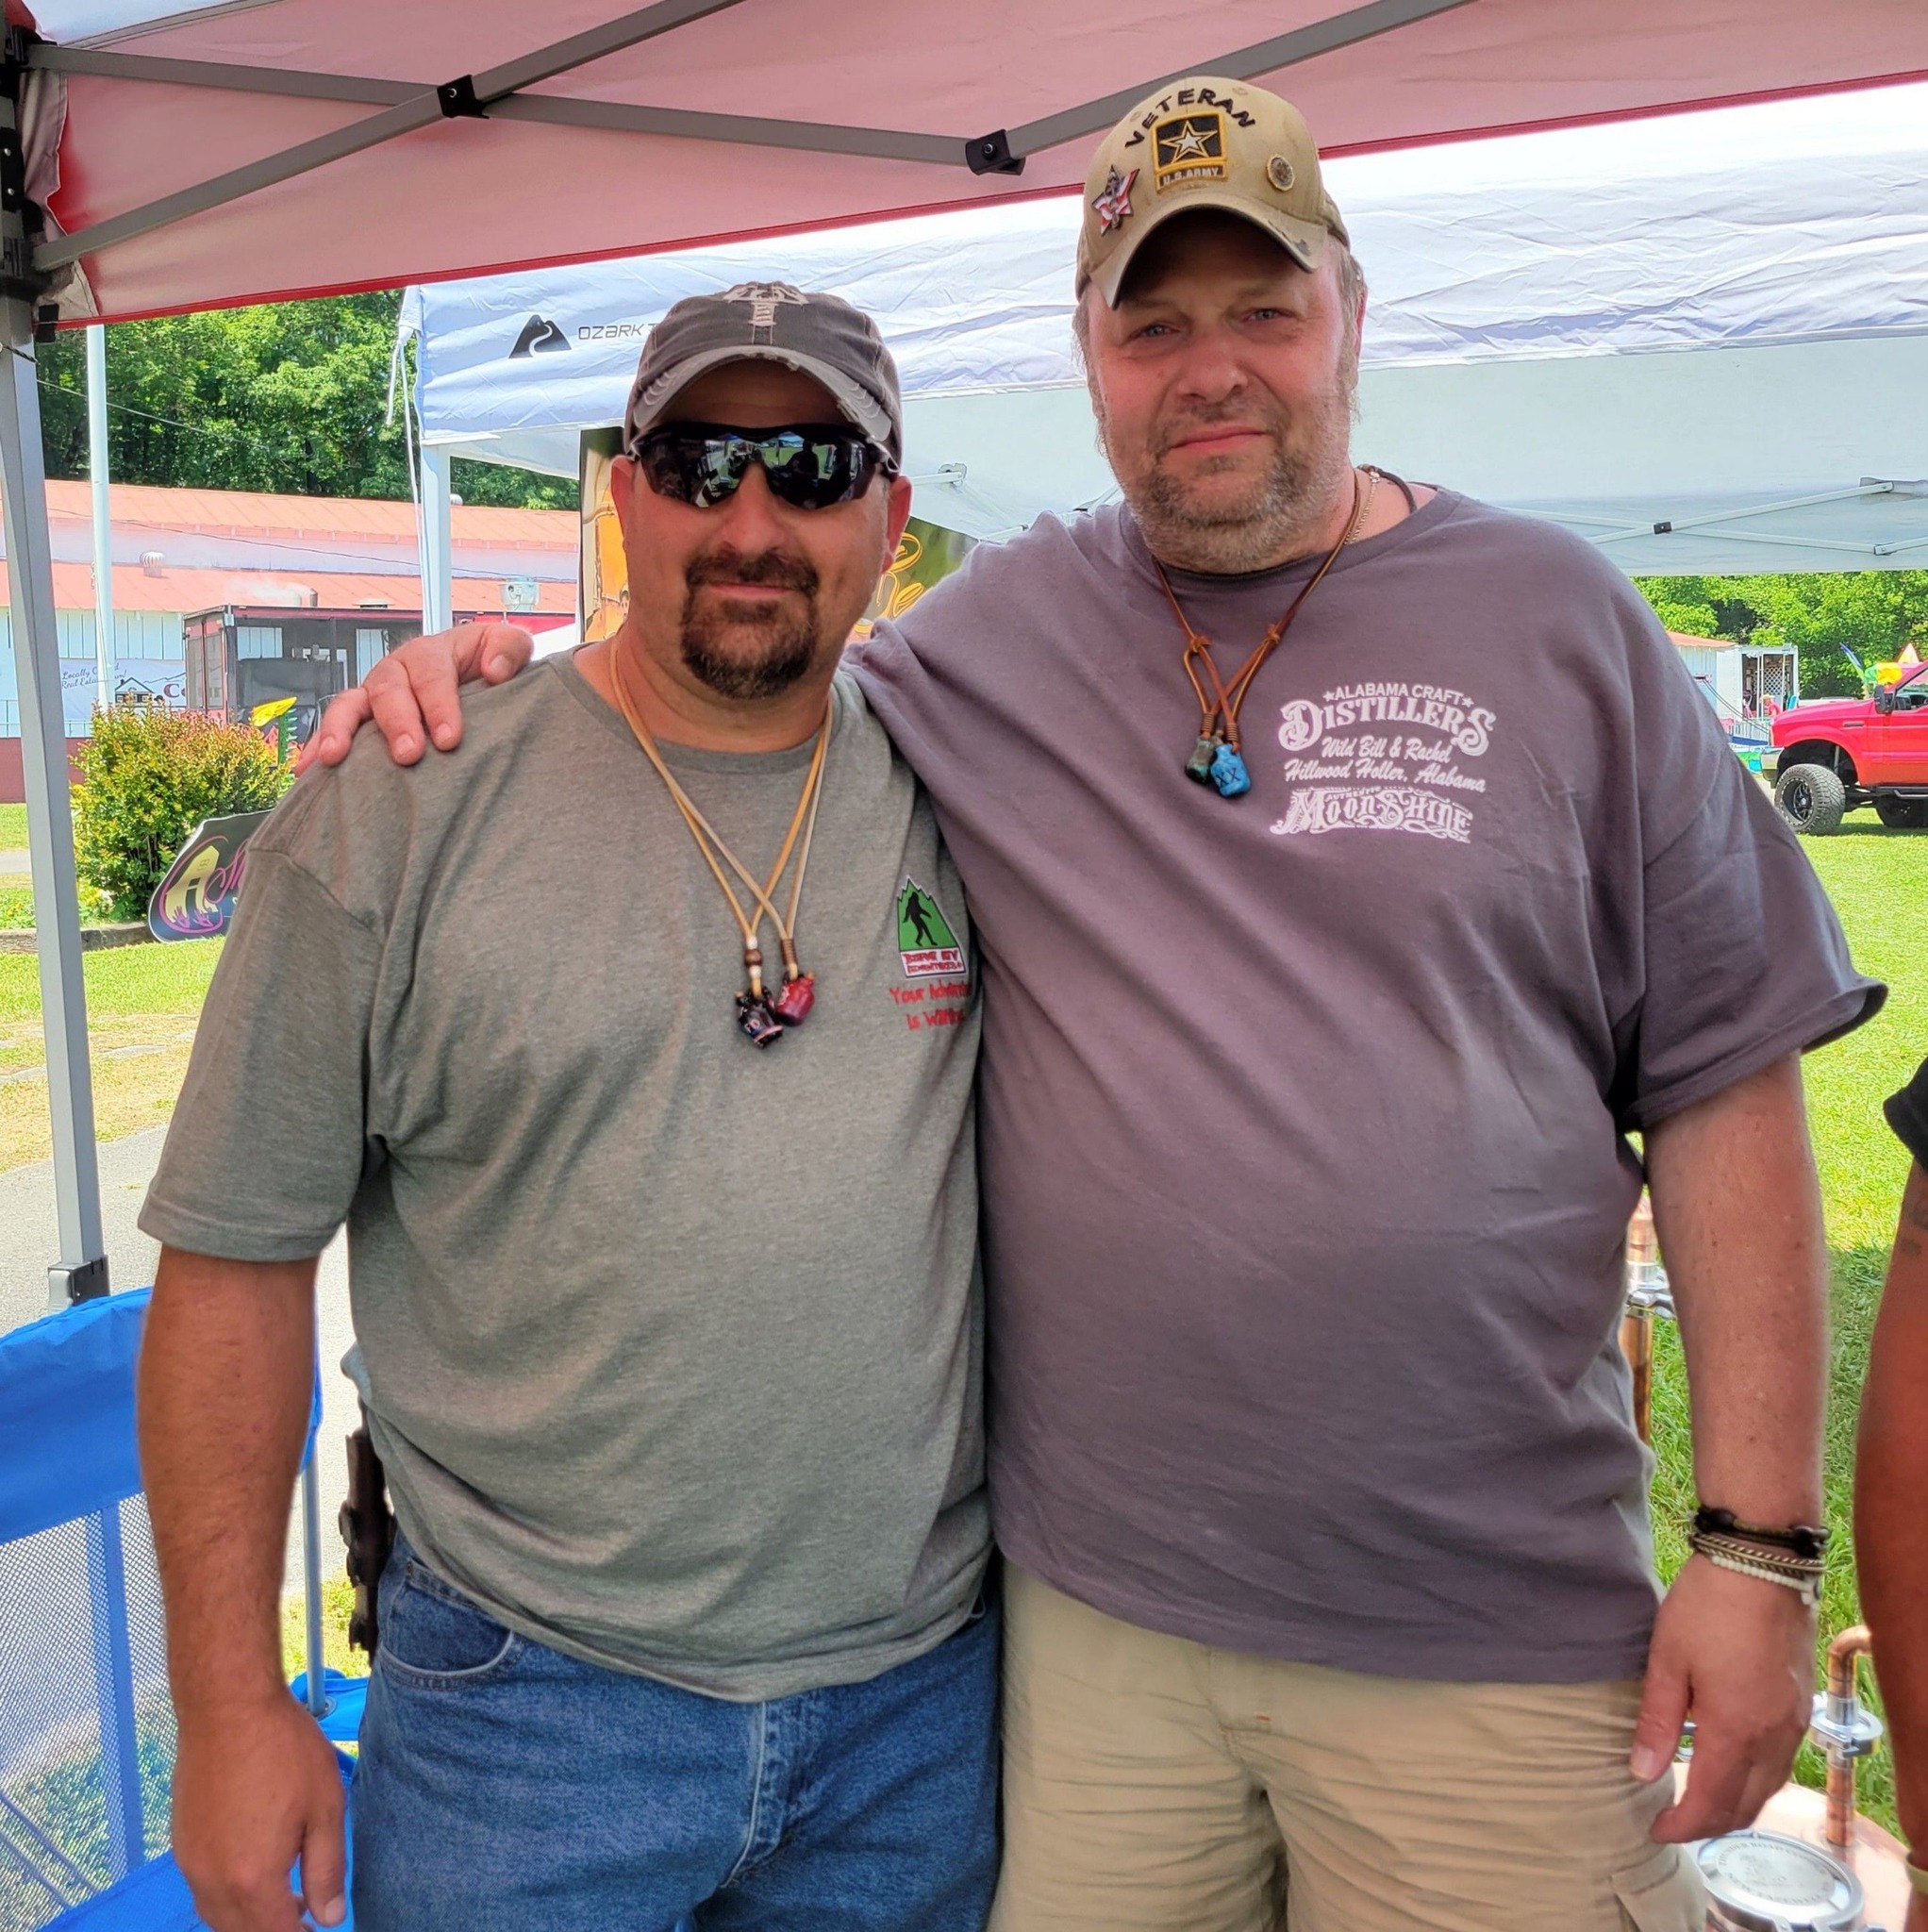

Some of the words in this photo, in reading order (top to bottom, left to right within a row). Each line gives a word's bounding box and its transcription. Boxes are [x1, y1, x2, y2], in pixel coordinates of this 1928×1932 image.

[1124, 88, 1255, 148] VETERAN
[578, 324, 644, 340] OZARK
[61, 680, 78, 690] Real
[62, 667, 90, 680] Locally
[1334, 682, 1408, 702] ALABAMA
[1411, 684, 1464, 706] CRAFT
[1278, 696, 1497, 757] DISTILLERS
[1321, 736, 1356, 758] Wild
[1357, 735, 1388, 758] Bill
[1388, 736, 1403, 758] &
[1284, 758, 1353, 782] Hillwood
[1355, 758, 1408, 782] Holler,
[1413, 762, 1487, 792] Alabama
